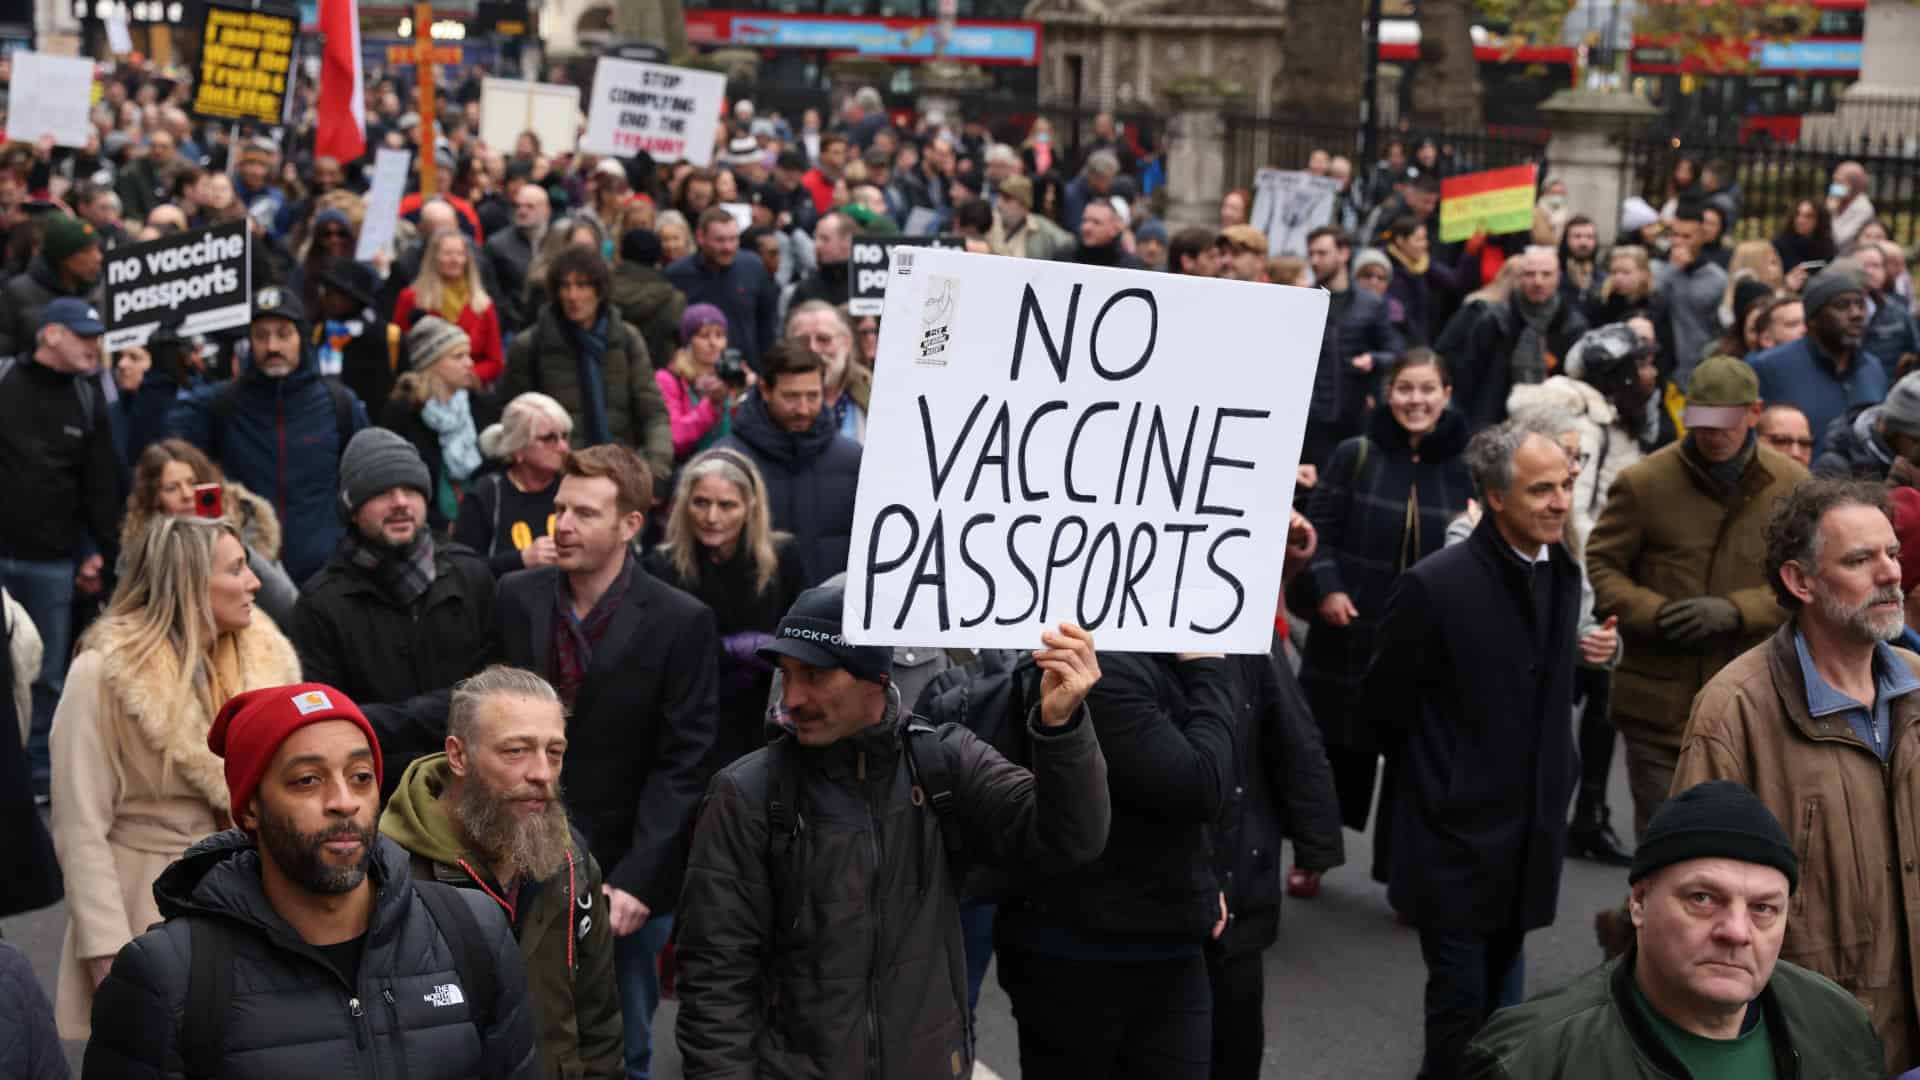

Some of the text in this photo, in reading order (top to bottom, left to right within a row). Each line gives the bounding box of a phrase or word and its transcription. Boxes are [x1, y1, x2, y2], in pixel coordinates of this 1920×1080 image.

[202, 63, 271, 91] Truth
[643, 71, 682, 88] STOP
[610, 87, 696, 113] COMPLYING
[619, 111, 685, 134] END THE
[614, 129, 685, 154] TYRANNY
[108, 232, 243, 284] no vaccine
[854, 244, 882, 264] no
[114, 263, 238, 322] passports
[1010, 282, 1158, 383] NO
[918, 393, 1272, 517] VACCINE
[863, 503, 1252, 635] PASSPORTS
